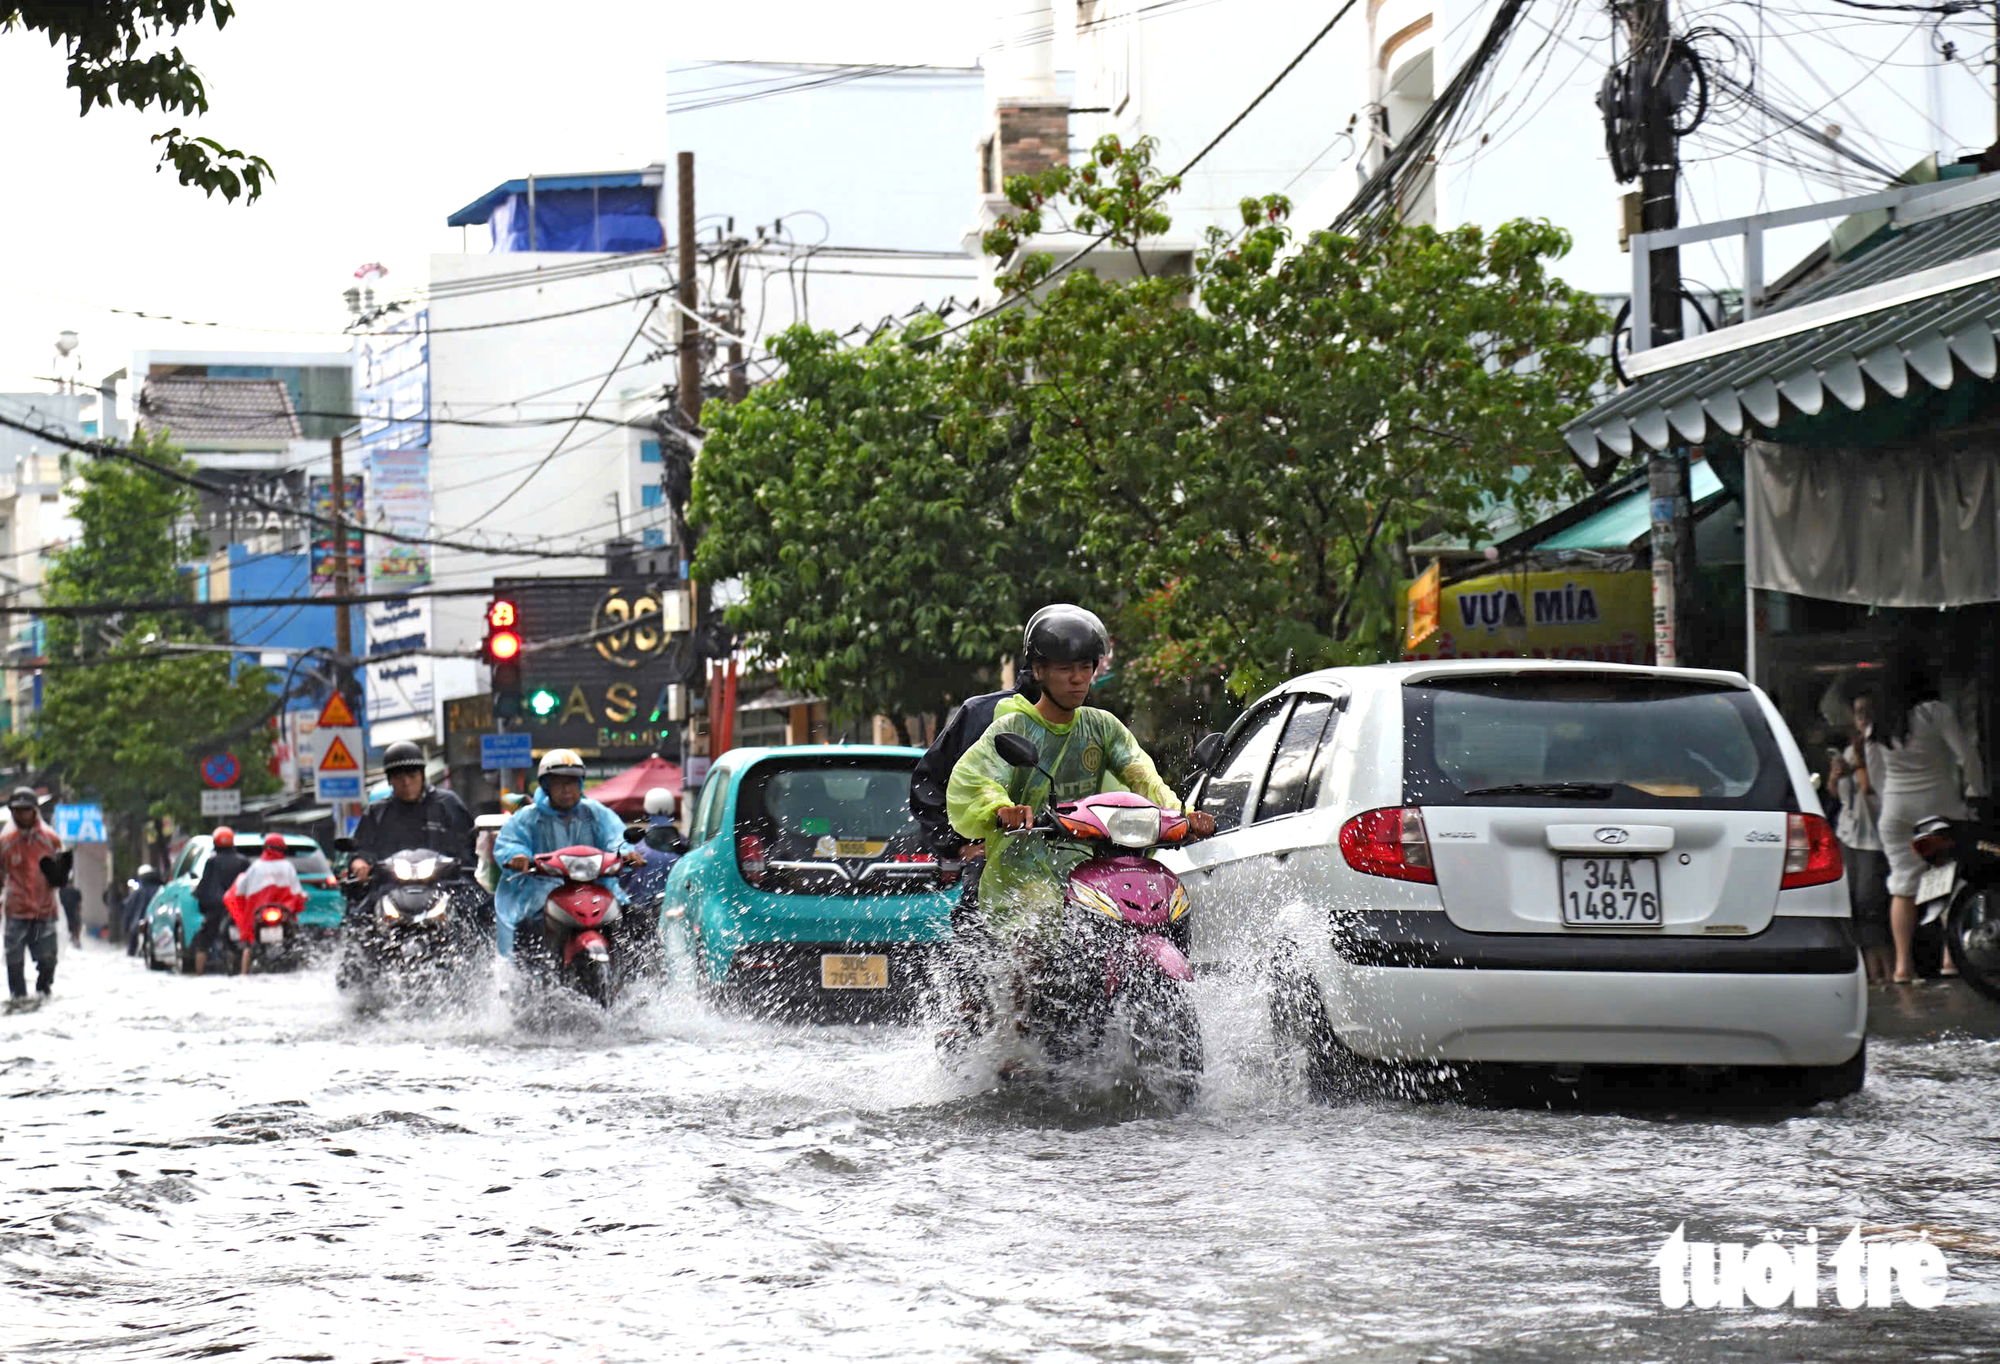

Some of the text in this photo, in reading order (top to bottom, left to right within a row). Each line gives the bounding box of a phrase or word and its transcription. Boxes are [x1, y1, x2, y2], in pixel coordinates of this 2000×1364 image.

[1459, 590, 1526, 632] VỰA
[1534, 582, 1598, 622] MÍA
[1583, 860, 1636, 890] 34A
[1568, 891, 1658, 921] 148.76
